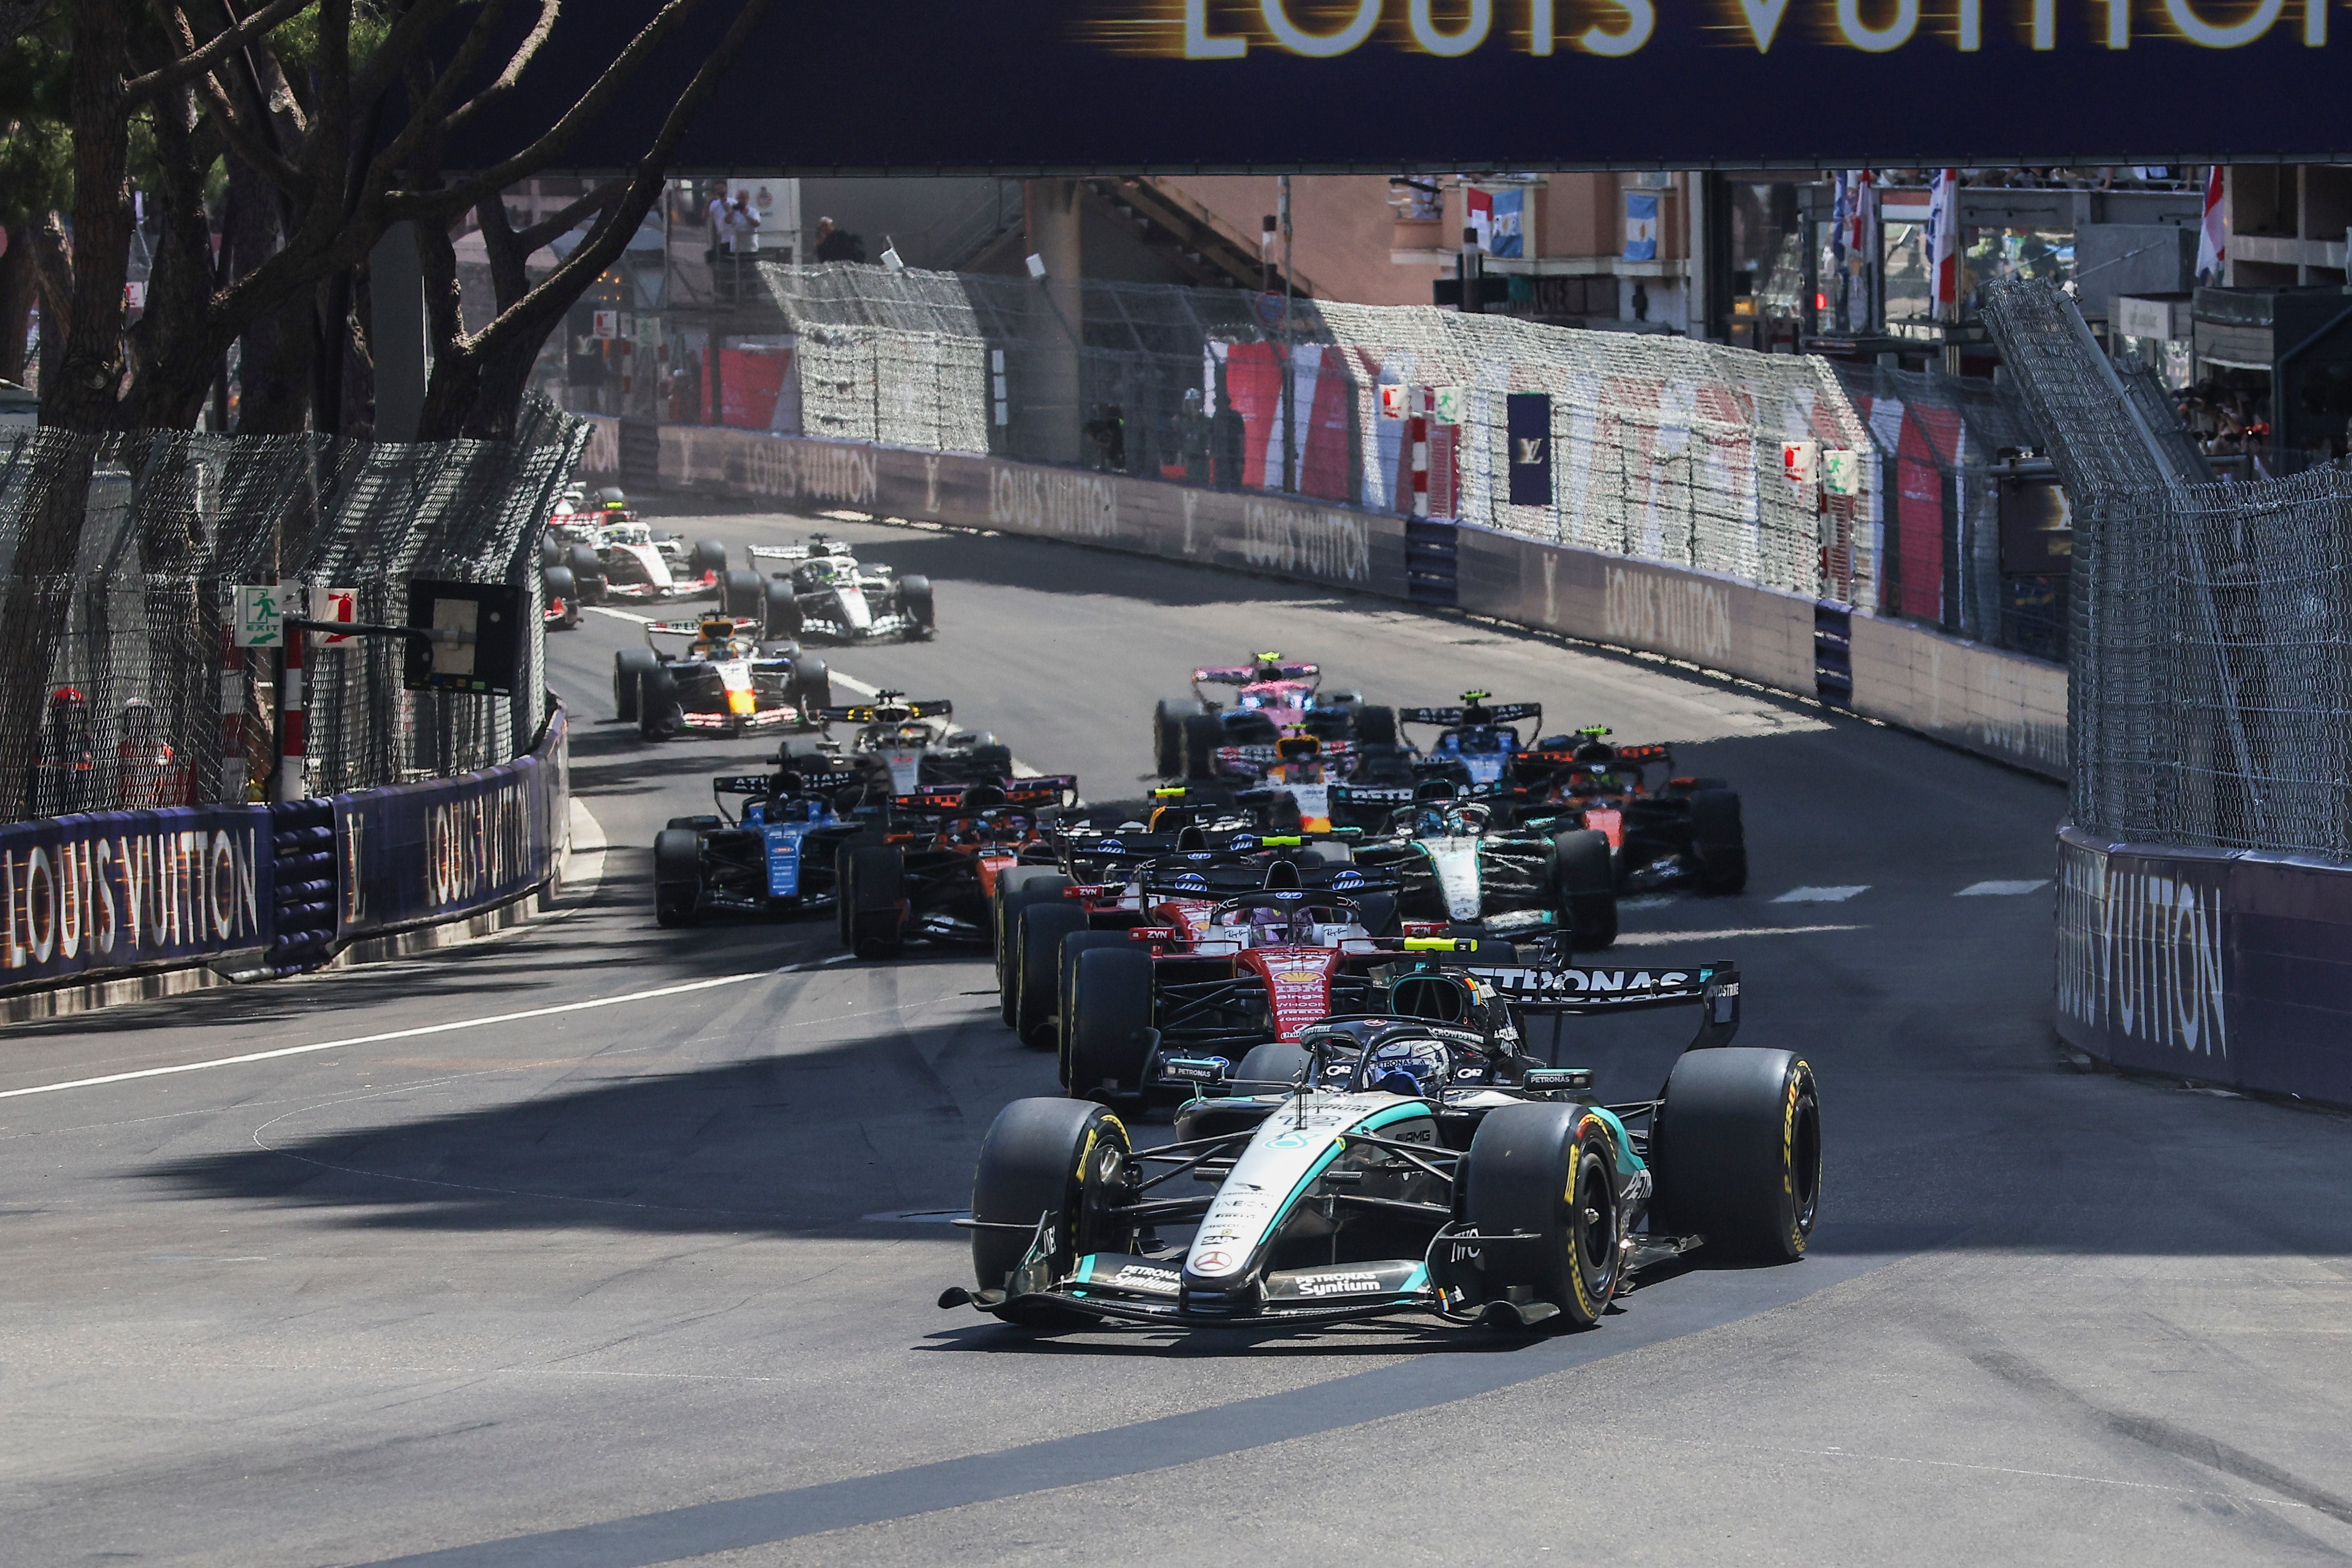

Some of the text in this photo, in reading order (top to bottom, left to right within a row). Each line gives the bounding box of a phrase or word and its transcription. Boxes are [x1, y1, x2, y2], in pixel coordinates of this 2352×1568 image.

[425, 781, 531, 907] LOUIS VUITTON
[5, 827, 259, 968] LOUIS VUITTON
[2096, 870, 2227, 1061] VUITTON
[1467, 967, 1689, 1002] ETRONAS
[1432, 1027, 1485, 1044] CROWDSTRIKE
[1178, 1067, 1211, 1078] PETRONAS
[1374, 1059, 1414, 1069] PETRONAS
[1278, 1115, 1342, 1126] 12
[1406, 1130, 1431, 1142] AMG
[1202, 1236, 1233, 1244] SAP
[1120, 1264, 1181, 1281] PETRONA
[1294, 1272, 1377, 1285] PETRONAS
[1107, 1272, 1180, 1291] Syntium
[1299, 1279, 1381, 1296] Syntium
